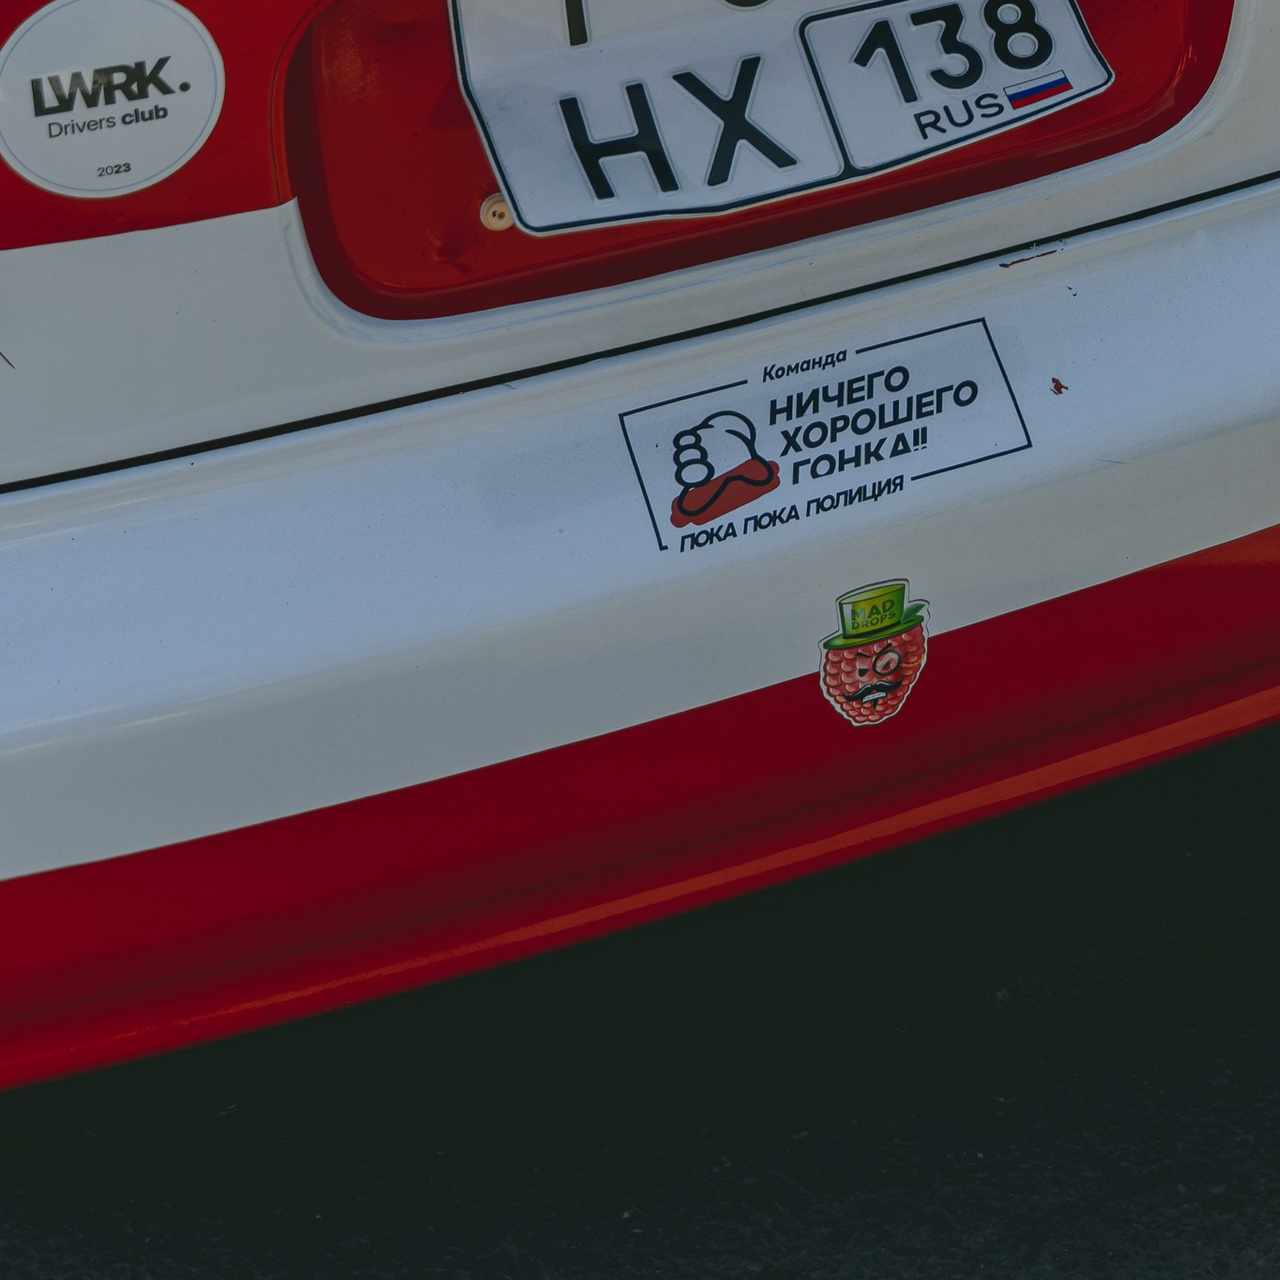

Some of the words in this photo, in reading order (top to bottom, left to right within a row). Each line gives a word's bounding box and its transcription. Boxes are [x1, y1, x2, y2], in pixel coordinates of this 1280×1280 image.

[30, 55, 191, 118] LWRK.
[48, 115, 116, 138] Drivers
[121, 104, 169, 125] club
[912, 92, 1006, 140] RUS
[97, 162, 132, 178] 2023
[762, 349, 848, 383] Команда
[768, 366, 910, 426] НИЧЕГО
[779, 379, 978, 457] ХОРОШЕГО
[680, 522, 737, 552] ПОКА
[742, 504, 800, 534] ПОКА
[805, 475, 904, 518] ПОЛИЦИЯ
[851, 599, 895, 622] MAD
[852, 609, 896, 630] DROPS
